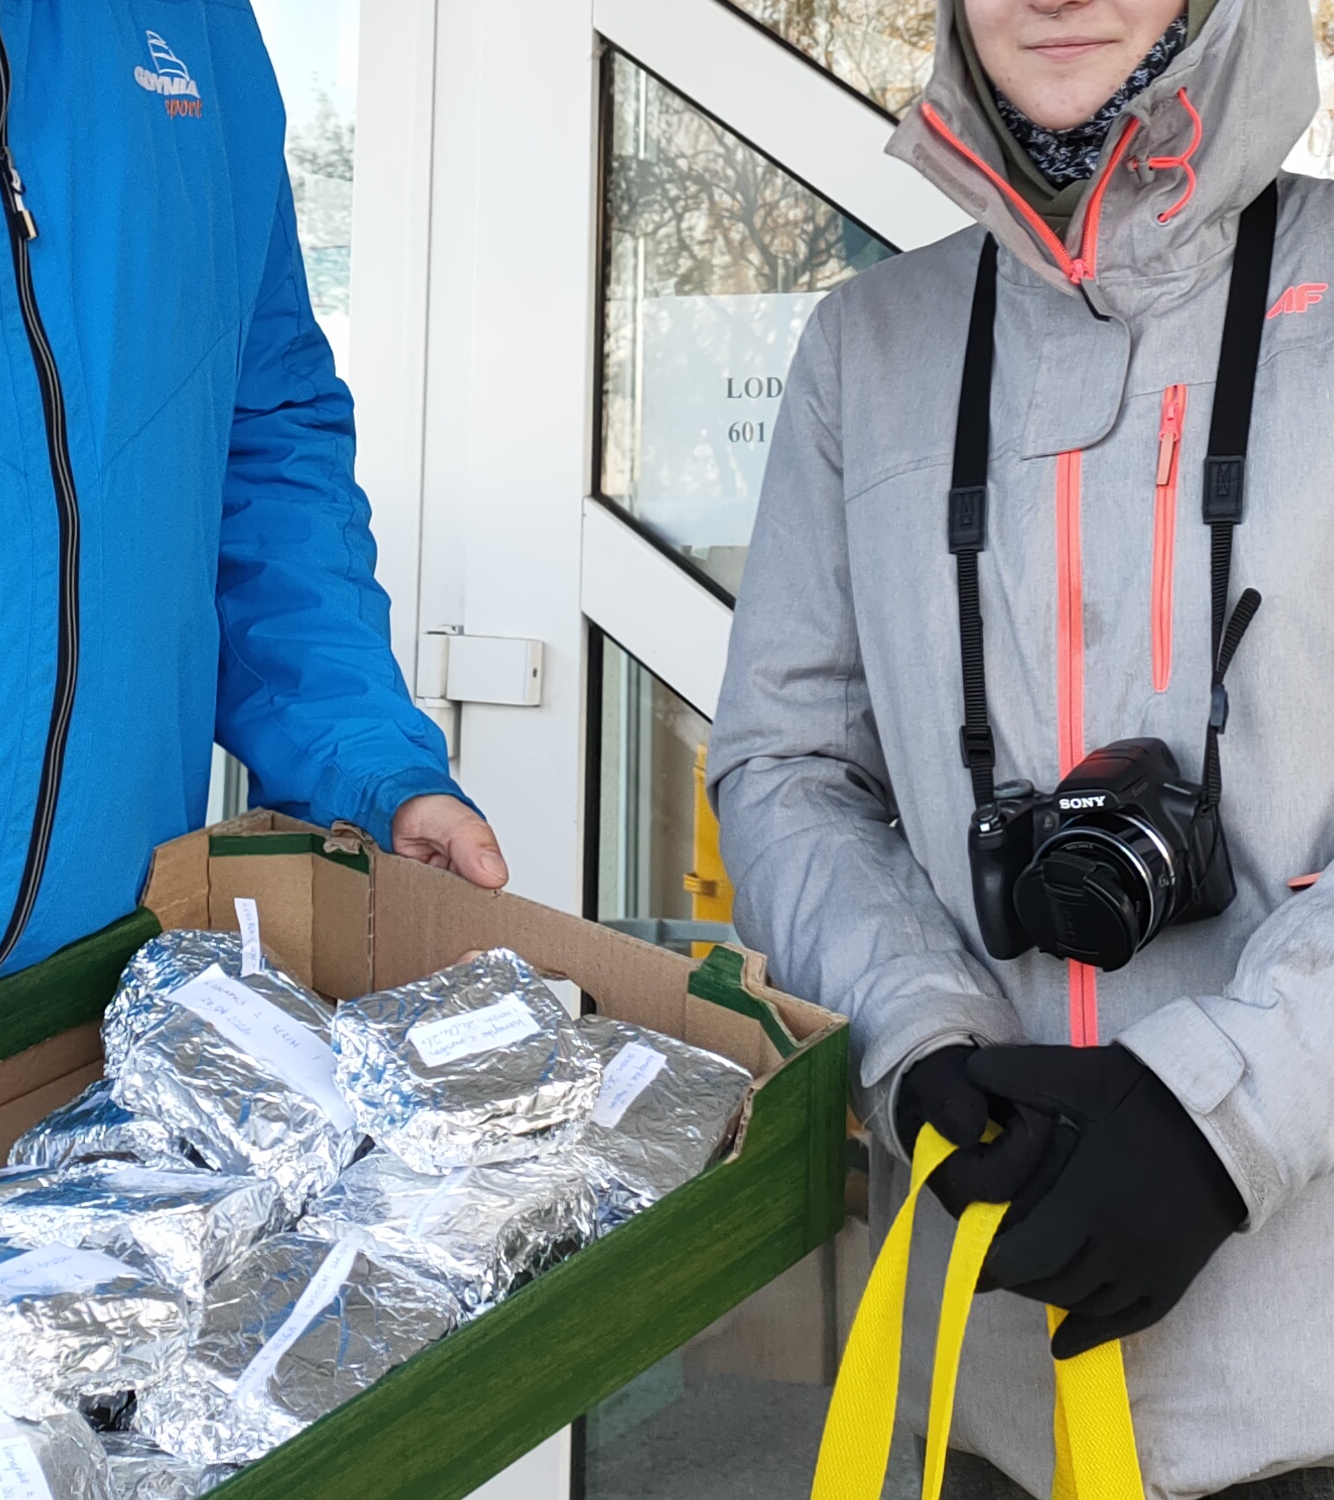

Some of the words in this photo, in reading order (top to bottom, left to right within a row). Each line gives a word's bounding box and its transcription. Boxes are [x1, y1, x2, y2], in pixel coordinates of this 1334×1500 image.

[134, 65, 201, 98] GDYNIA
[727, 421, 766, 443] 601
[1059, 796, 1107, 810] SONY
